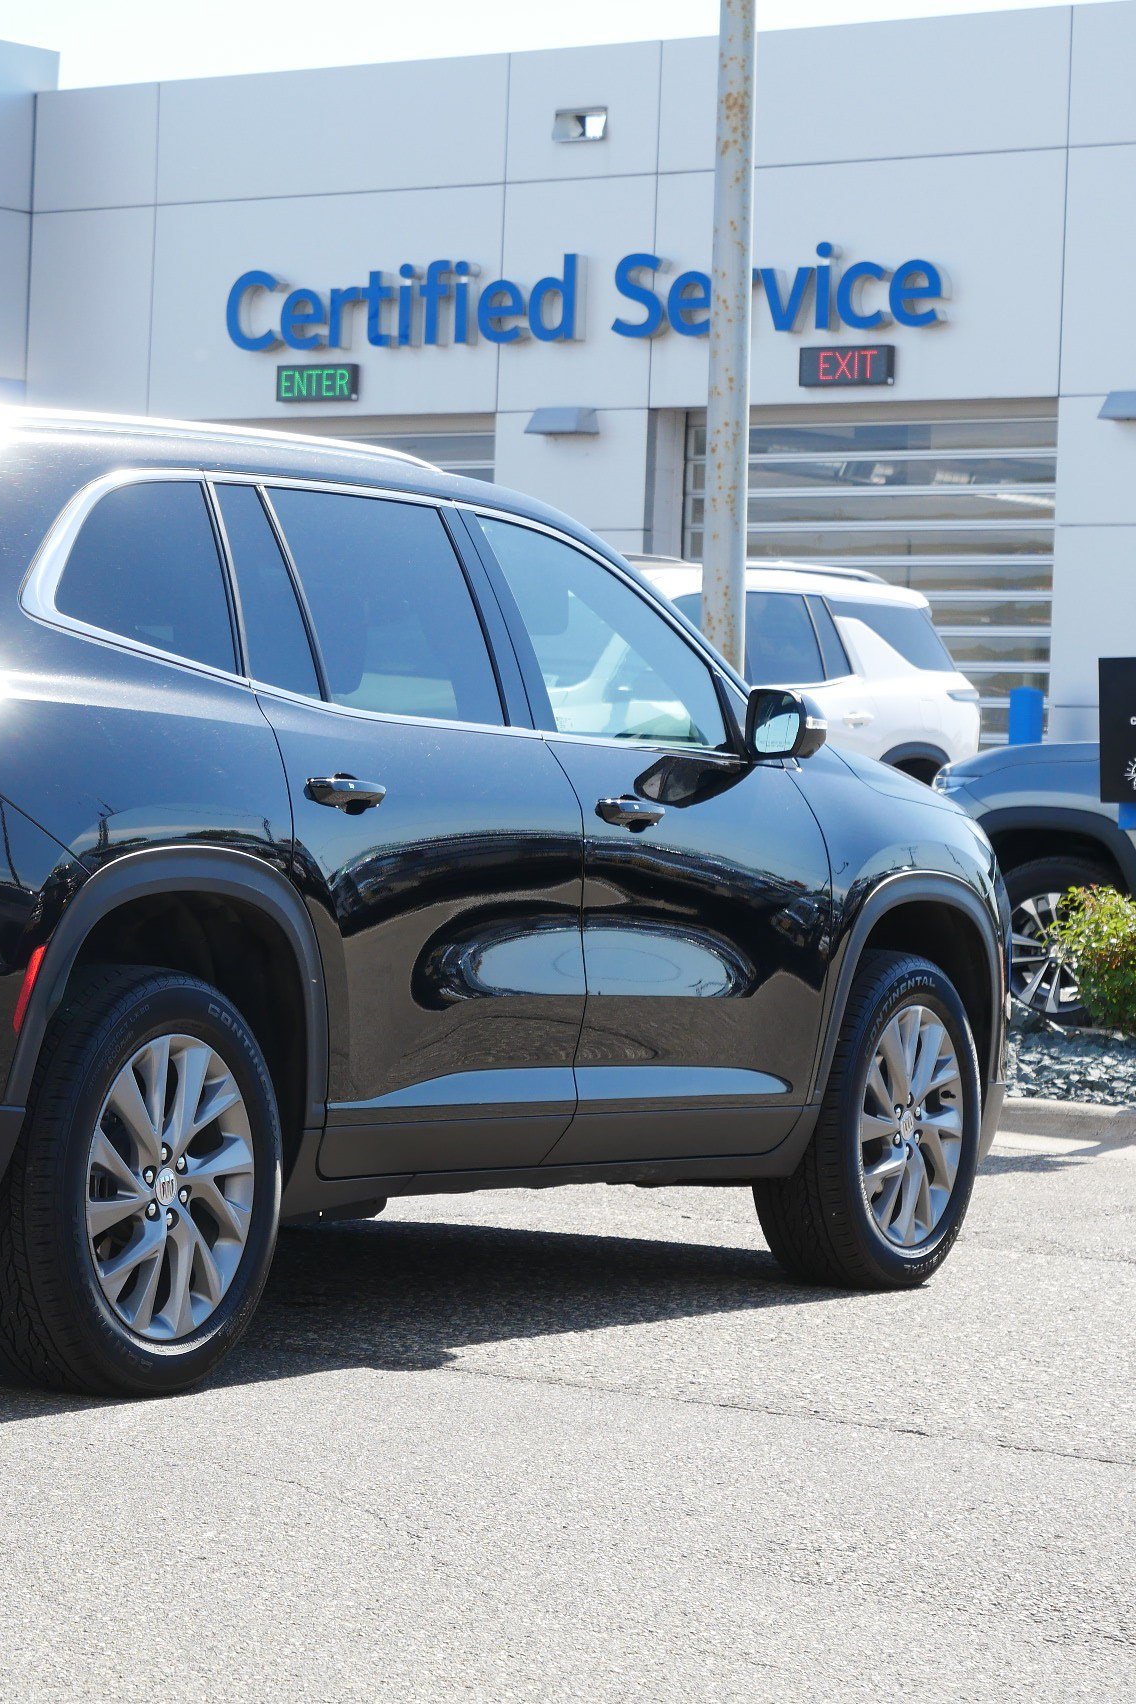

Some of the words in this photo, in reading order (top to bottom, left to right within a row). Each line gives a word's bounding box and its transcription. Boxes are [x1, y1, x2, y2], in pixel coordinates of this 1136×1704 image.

[226, 253, 581, 351] Certified
[611, 242, 944, 338] Sevice
[818, 350, 878, 381] EXIT
[280, 369, 351, 398] ENTER
